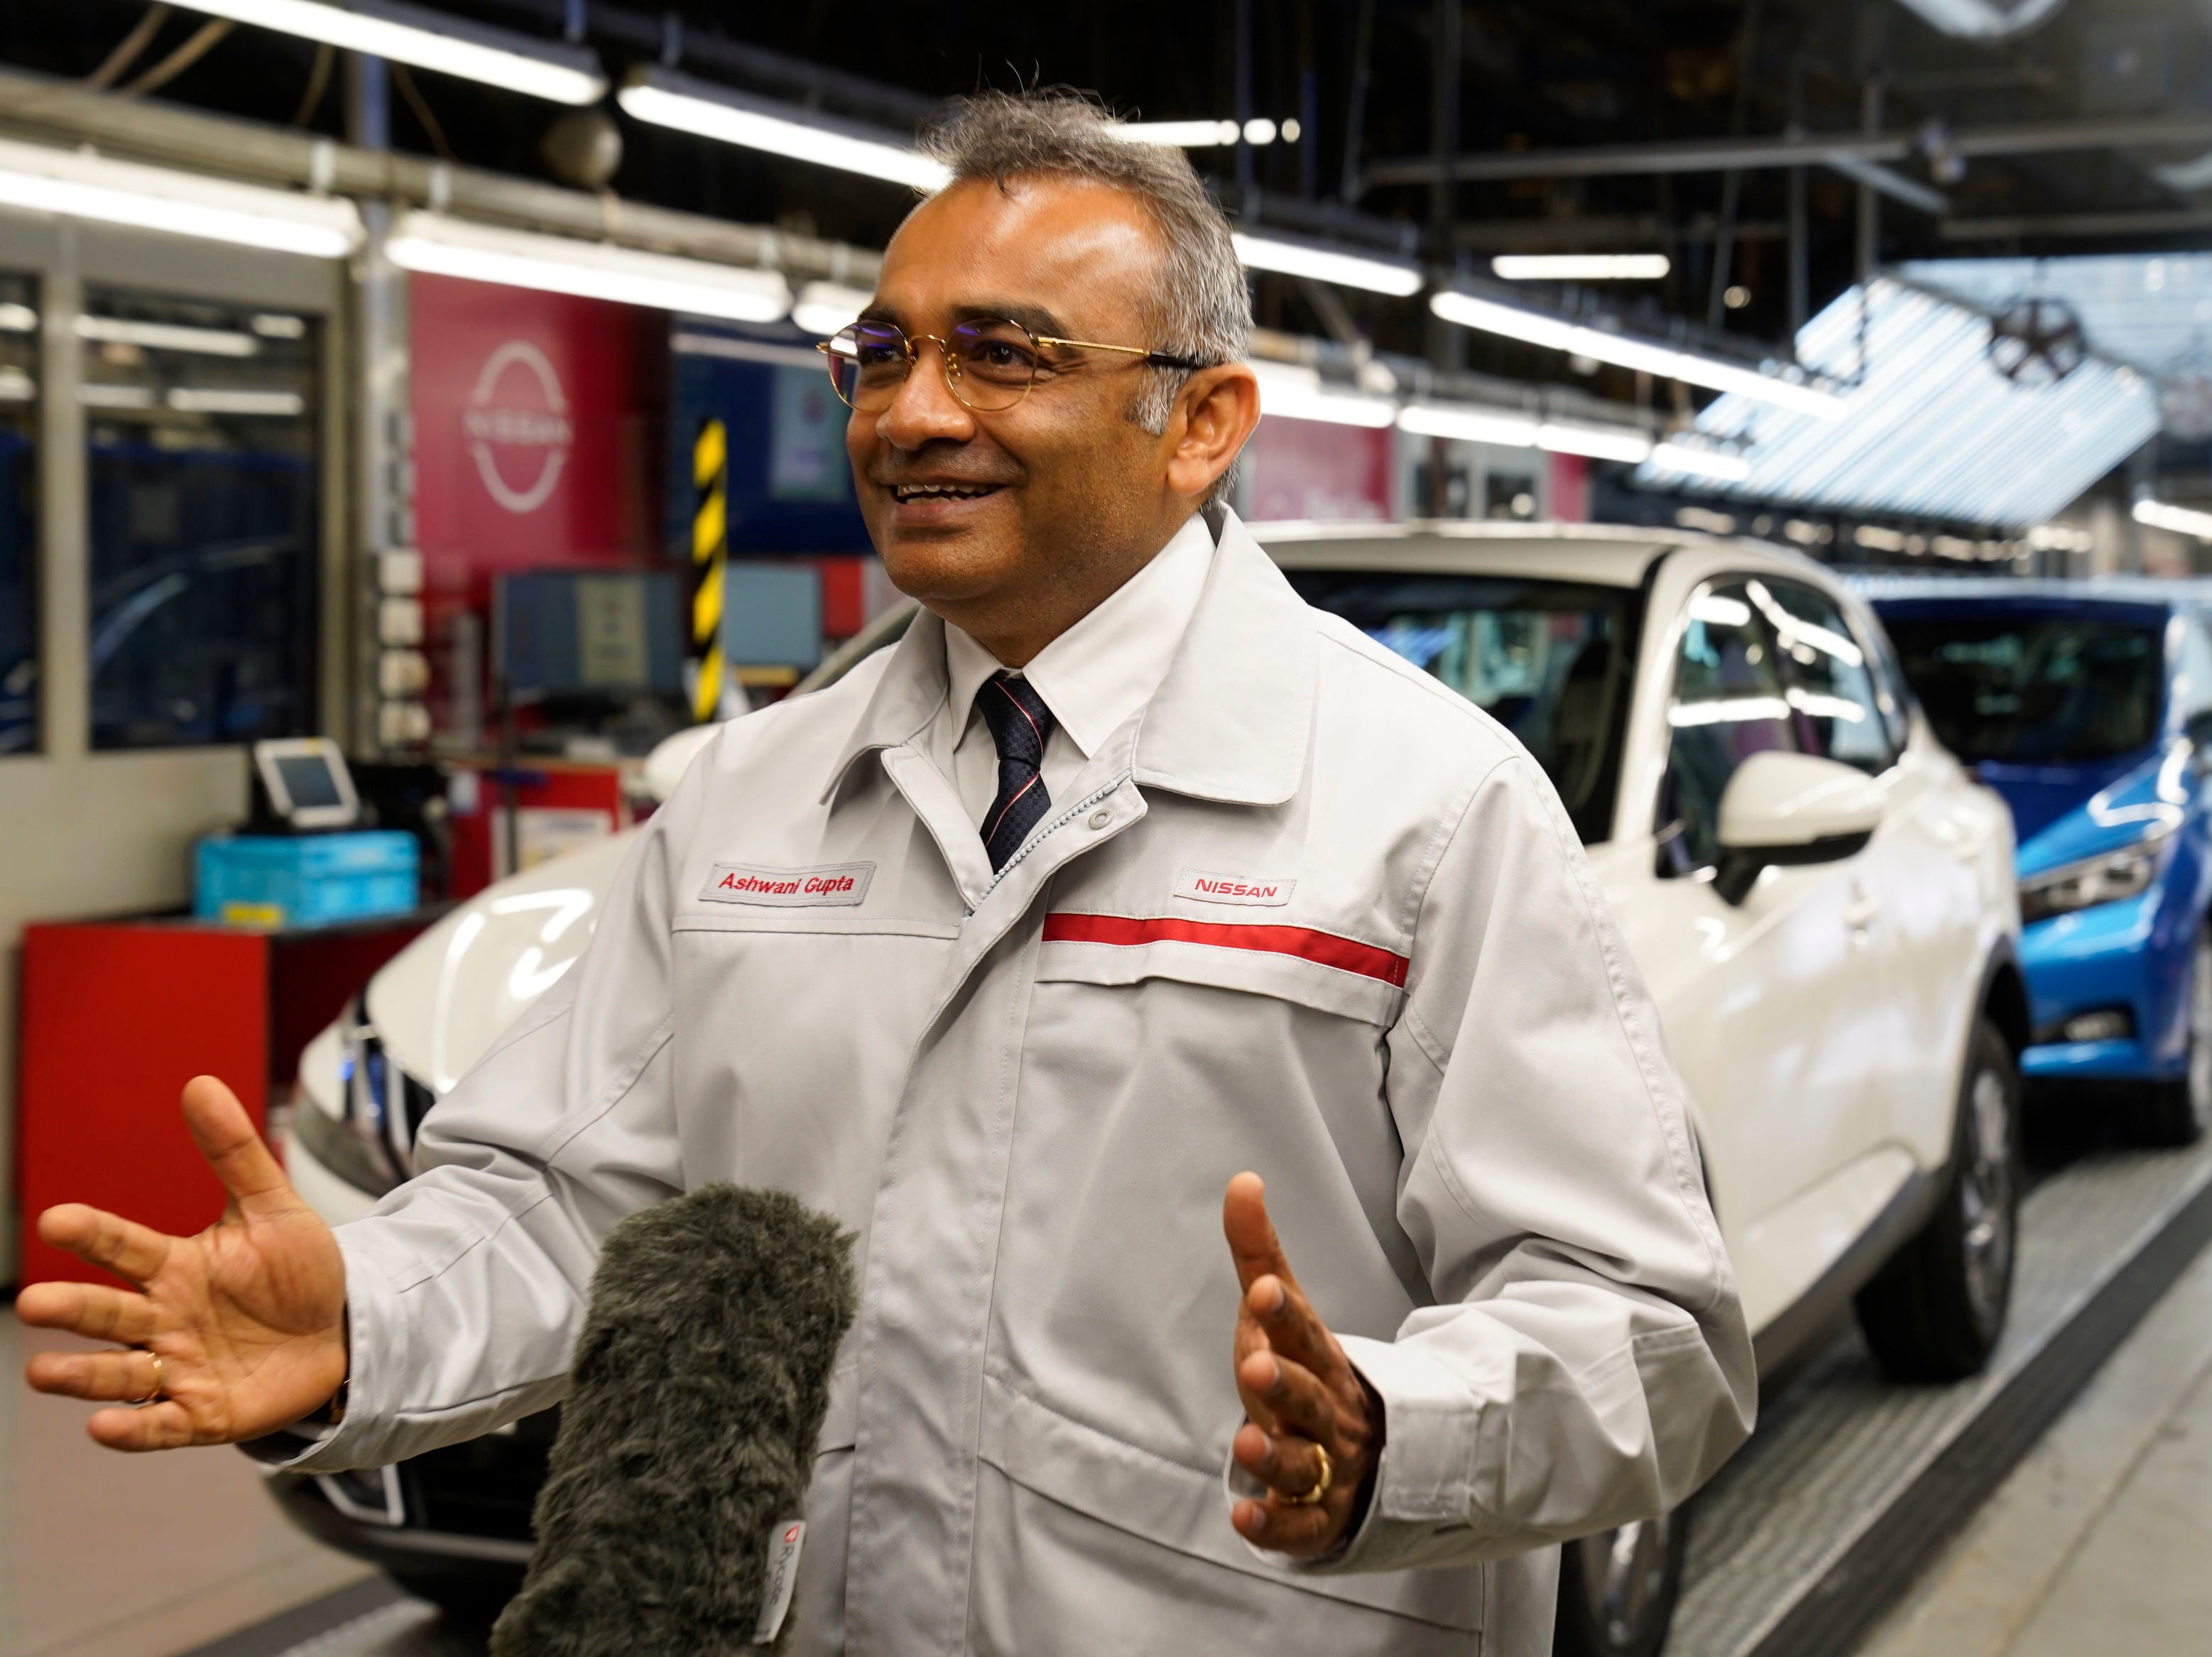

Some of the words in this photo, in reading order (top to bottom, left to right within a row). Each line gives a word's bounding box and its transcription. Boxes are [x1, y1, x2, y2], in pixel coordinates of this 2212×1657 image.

[465, 409, 573, 445] NISSAN
[719, 873, 802, 894] Ashwani
[804, 875, 855, 896] Gupta
[1194, 879, 1277, 898] NISSAN
